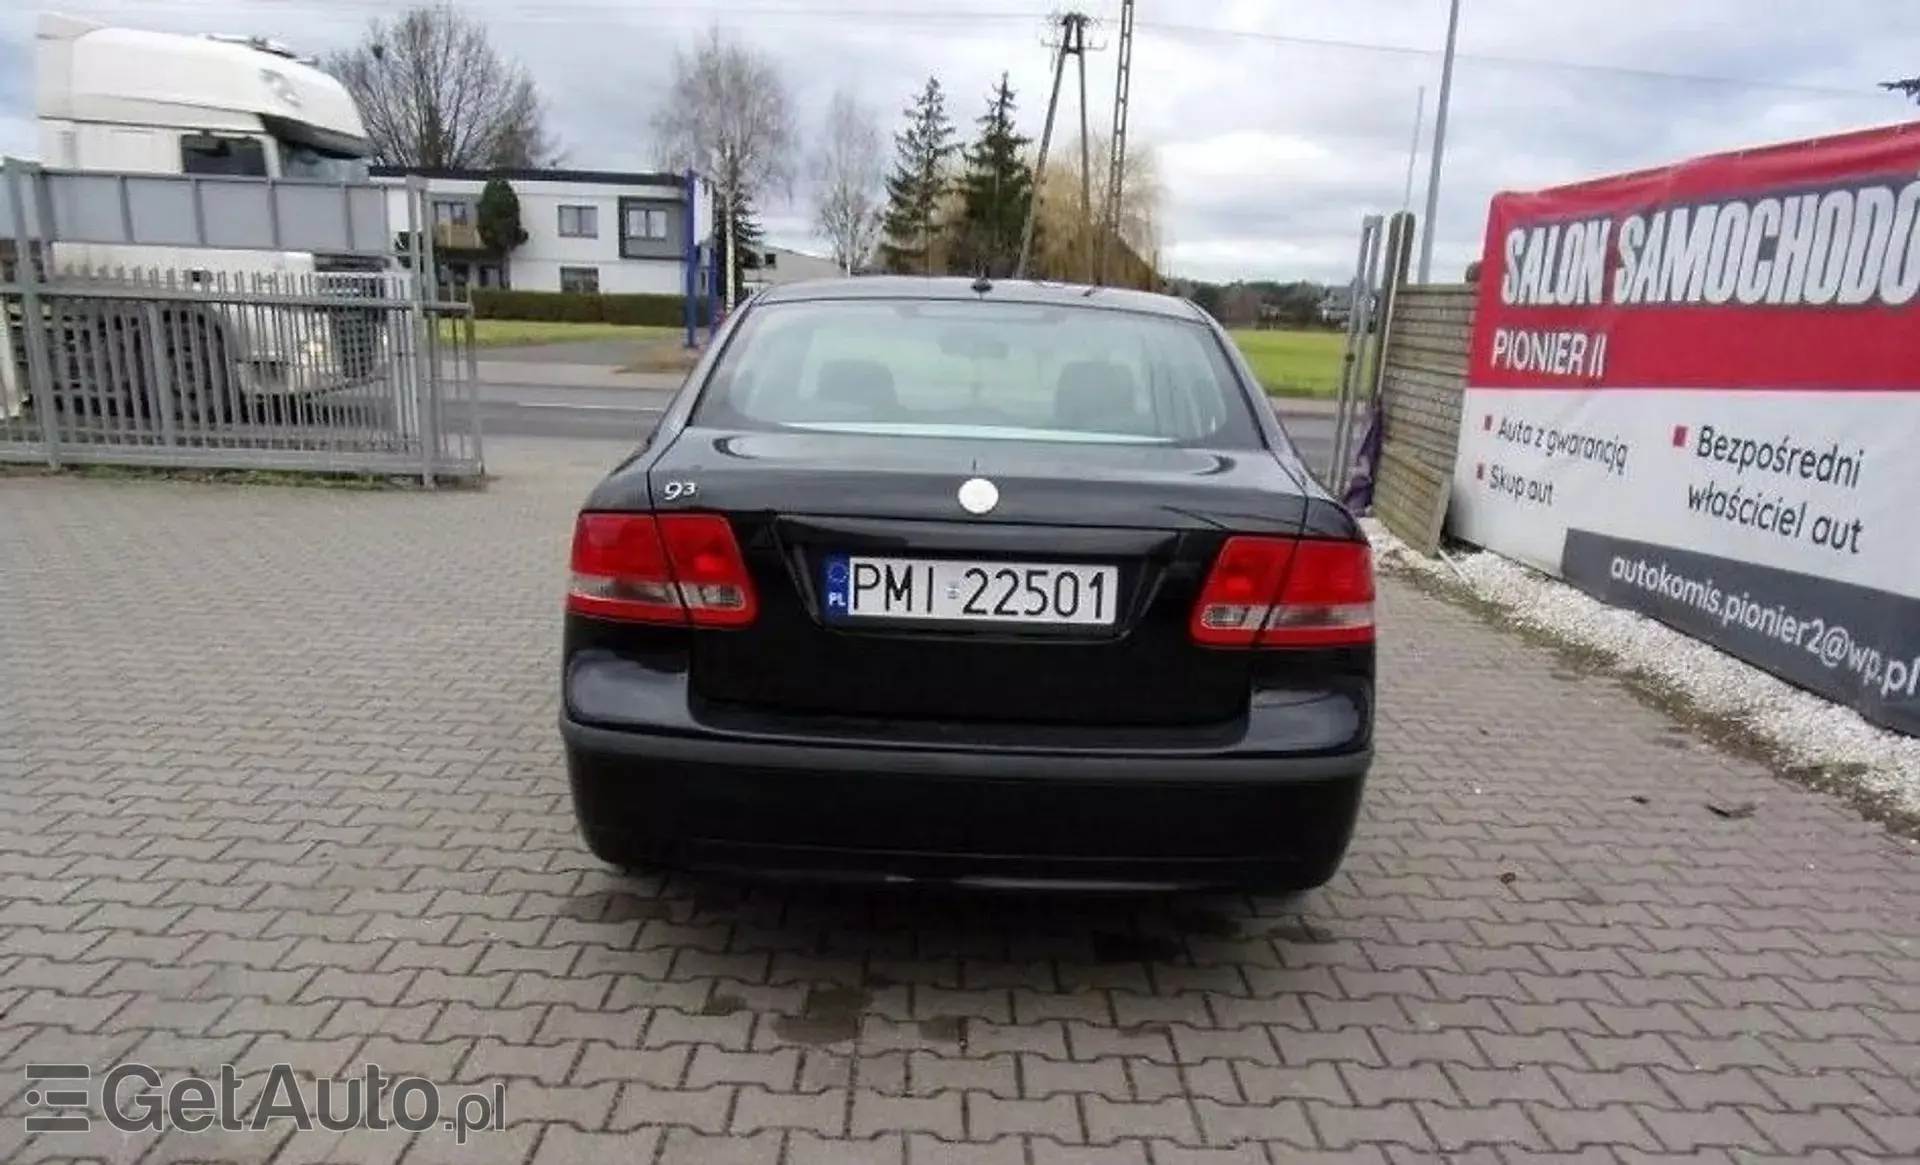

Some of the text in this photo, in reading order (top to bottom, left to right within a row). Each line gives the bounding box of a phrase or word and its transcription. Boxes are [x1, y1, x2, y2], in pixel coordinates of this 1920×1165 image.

[1502, 220, 1611, 305] SALON
[1491, 328, 1608, 377] PIONIER II
[1533, 427, 1544, 447] z
[1545, 430, 1628, 476] gwarancją
[1697, 425, 1864, 489] Bezpośredni
[1489, 464, 1554, 506] Skup aut
[1688, 482, 1864, 553] właściciel aut
[828, 592, 847, 607] PL
[852, 563, 1103, 619] PMI 22501
[1611, 554, 1920, 697] autokomis.pionier2@wp.pl
